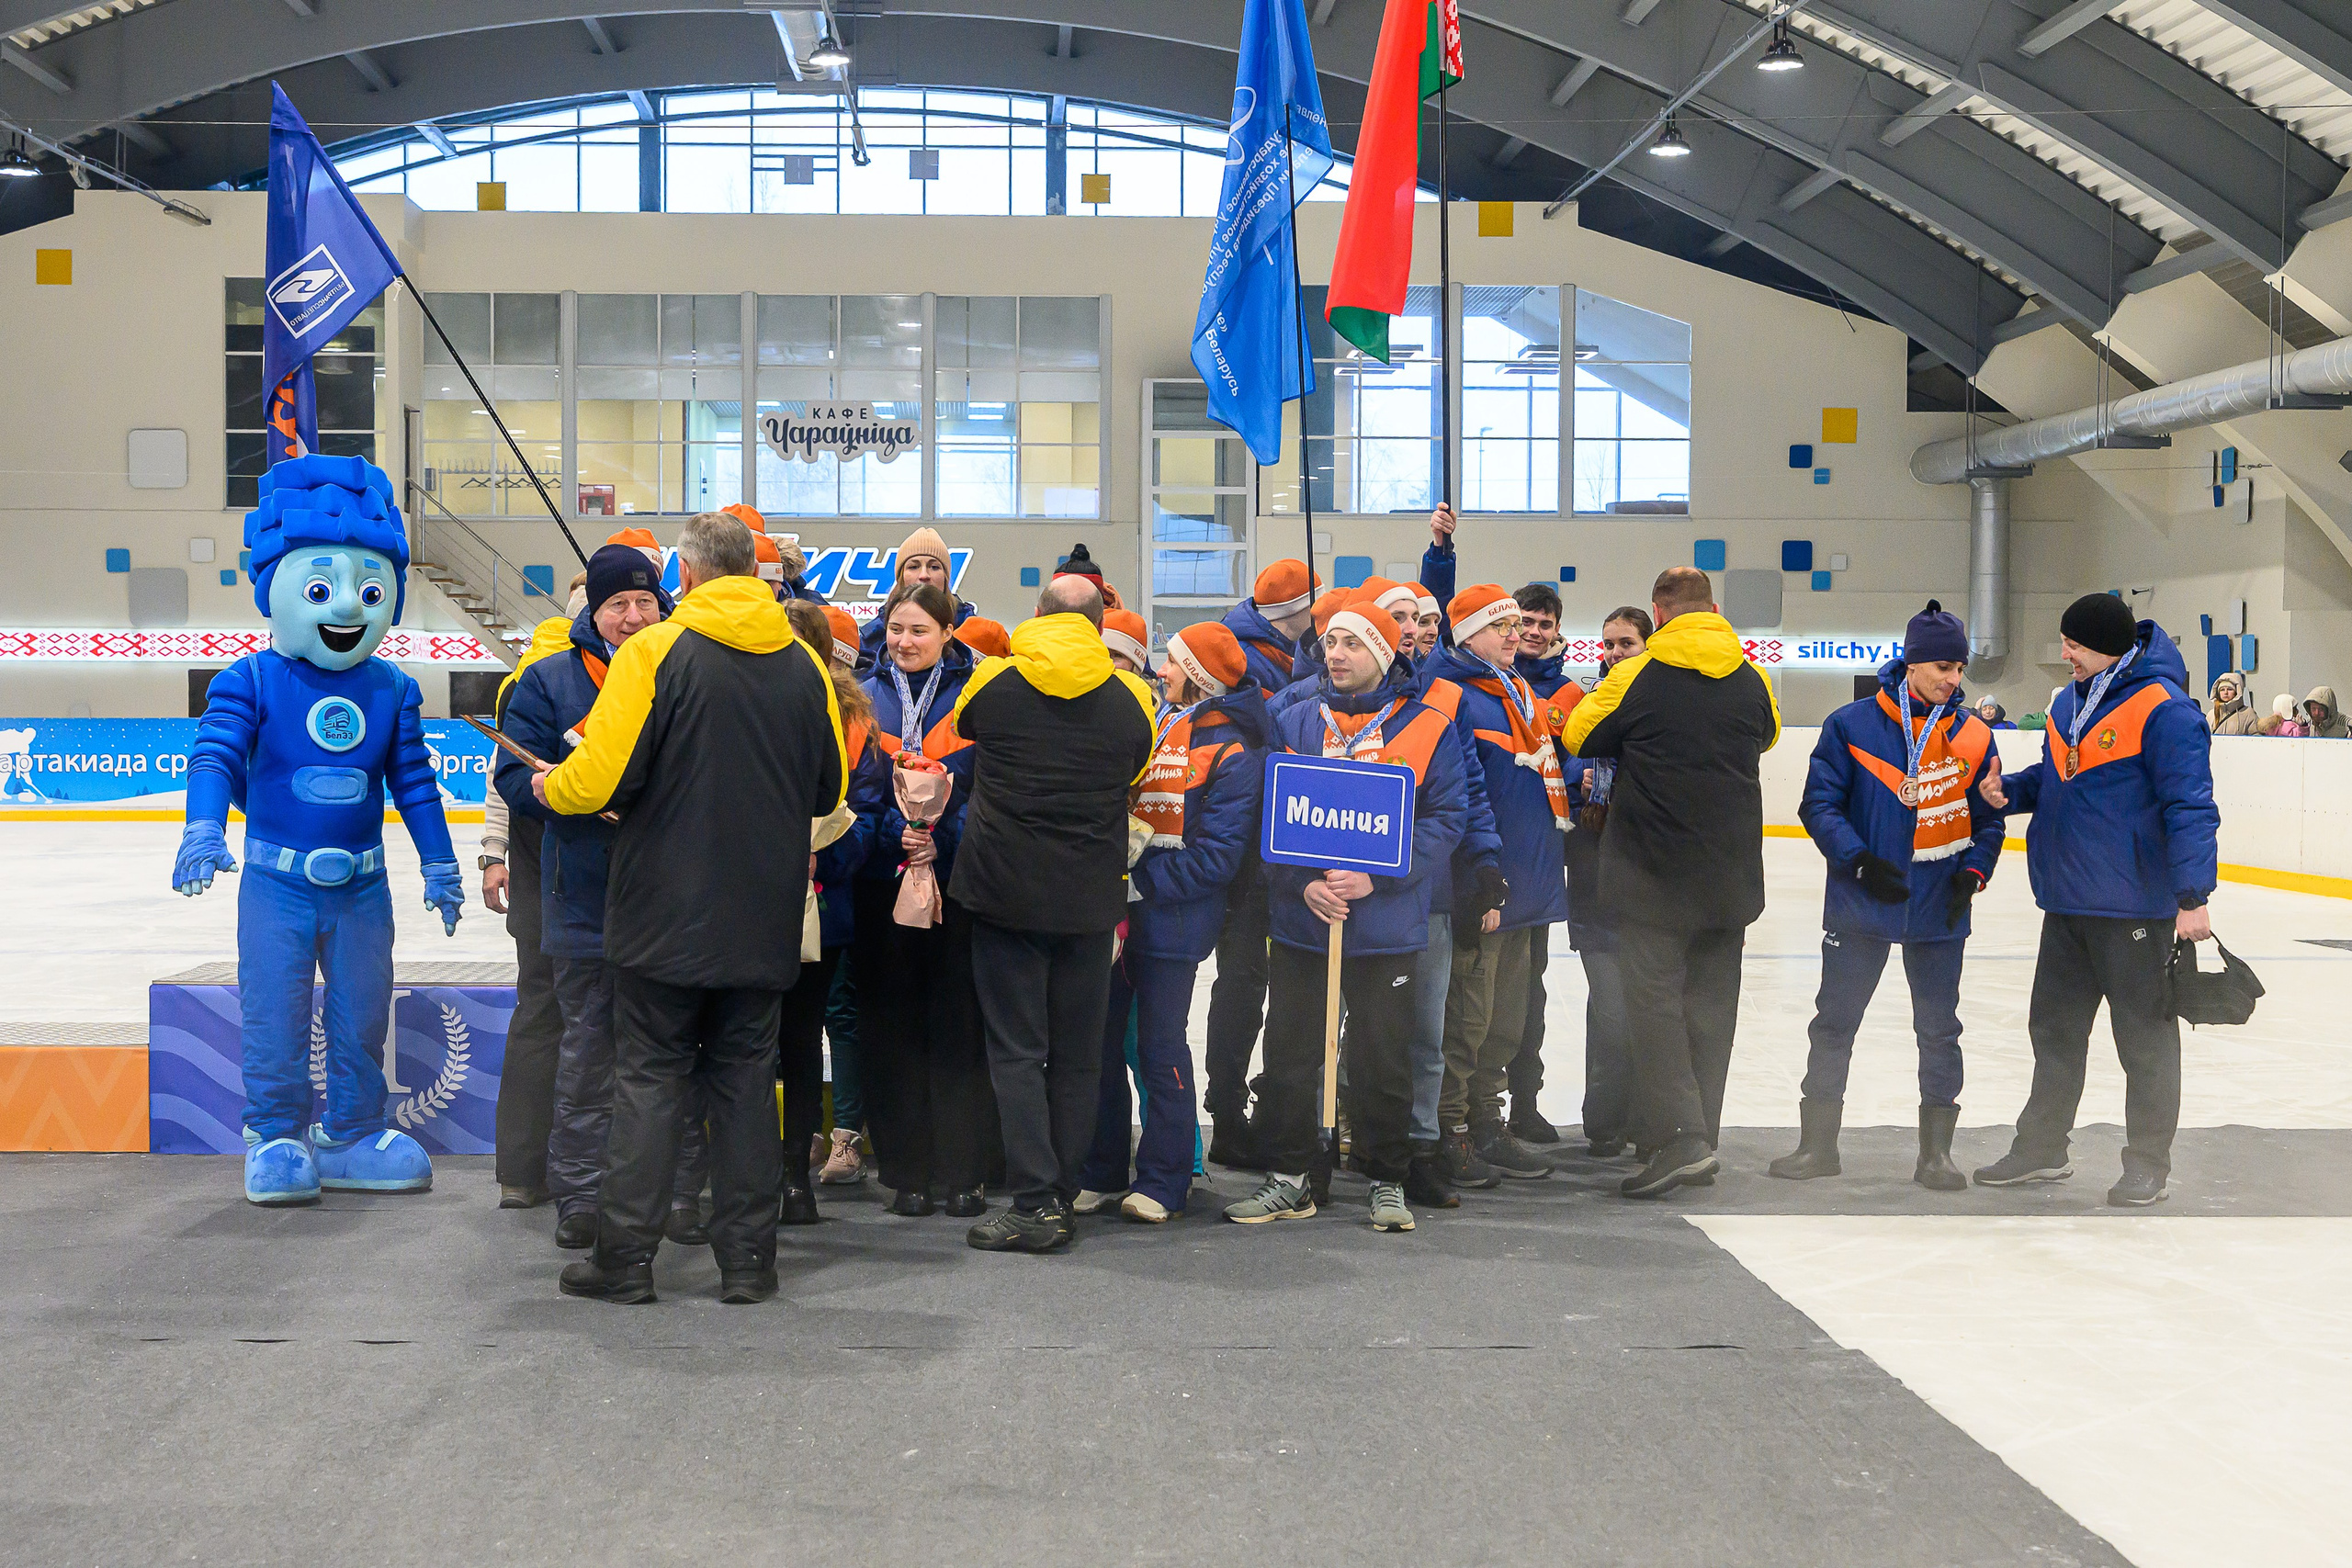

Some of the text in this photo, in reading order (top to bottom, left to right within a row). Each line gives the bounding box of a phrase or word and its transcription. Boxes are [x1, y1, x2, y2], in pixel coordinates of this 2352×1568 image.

[1204, 328, 1239, 397] Беларусь
[812, 407, 868, 420] КАФЕ
[1798, 641, 1905, 663] silichy.b
[1182, 657, 1216, 692] БЕЛАРУСЬ
[1286, 795, 1390, 836] Молния
